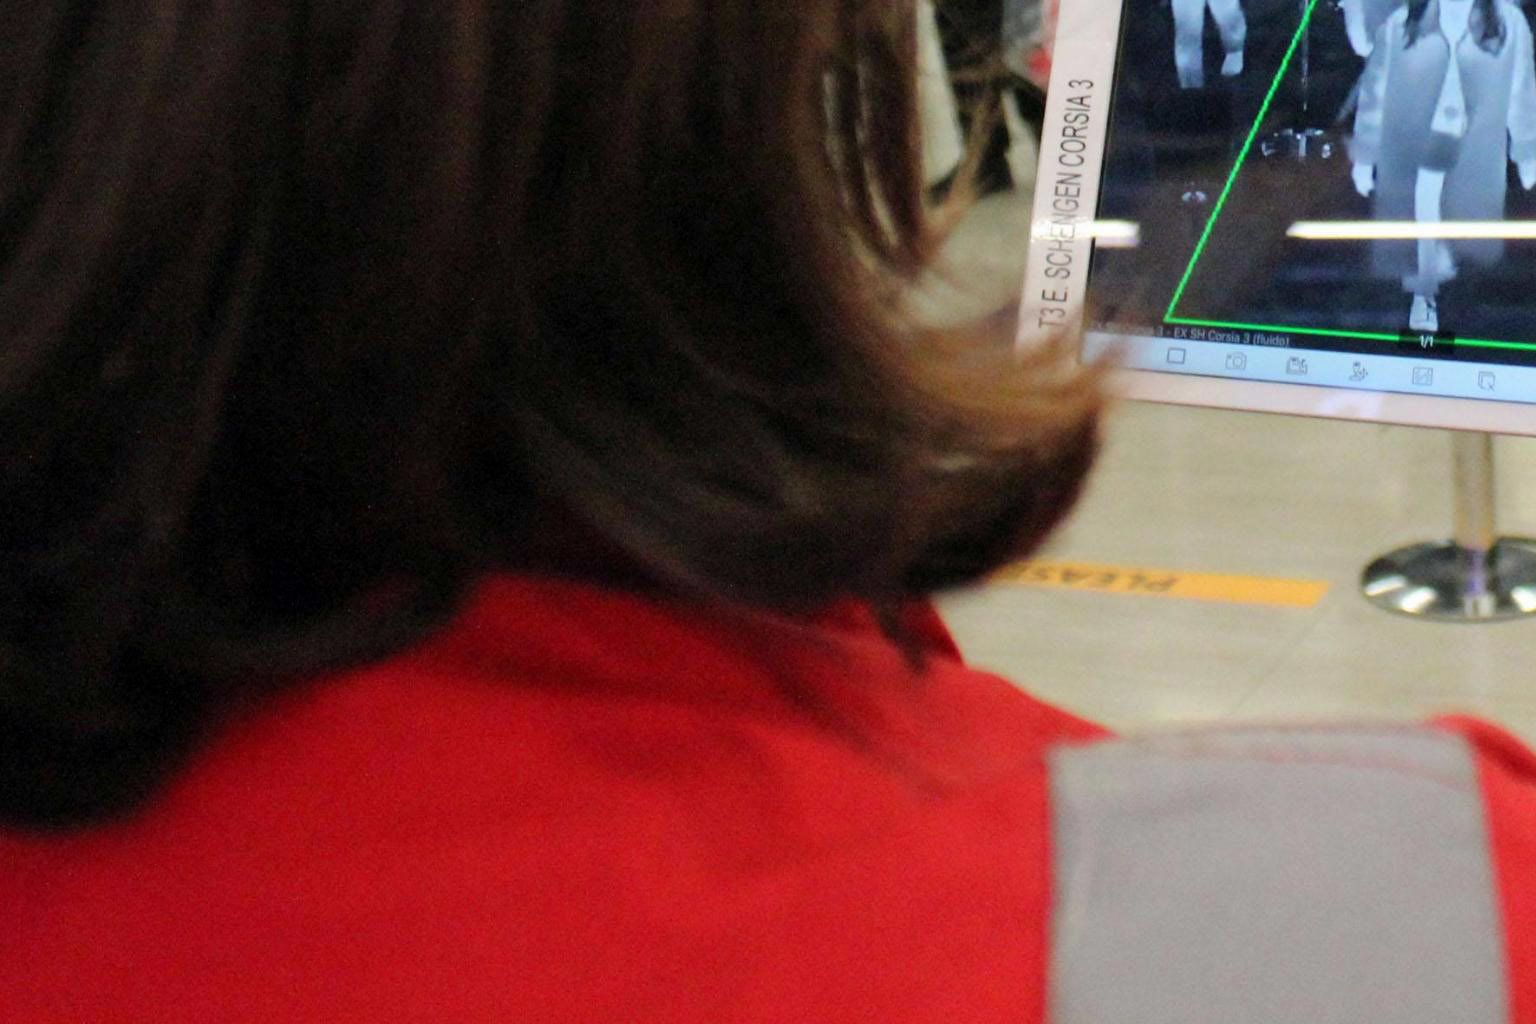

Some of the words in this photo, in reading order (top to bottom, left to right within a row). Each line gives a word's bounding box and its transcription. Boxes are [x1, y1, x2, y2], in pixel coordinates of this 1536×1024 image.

[1068, 79, 1094, 90] 3
[1058, 95, 1092, 168] CORSIA
[1044, 173, 1081, 280] SCHENGEN
[1038, 307, 1066, 328] T3
[1208, 329, 1240, 343] Corsia
[1243, 332, 1249, 344] 3
